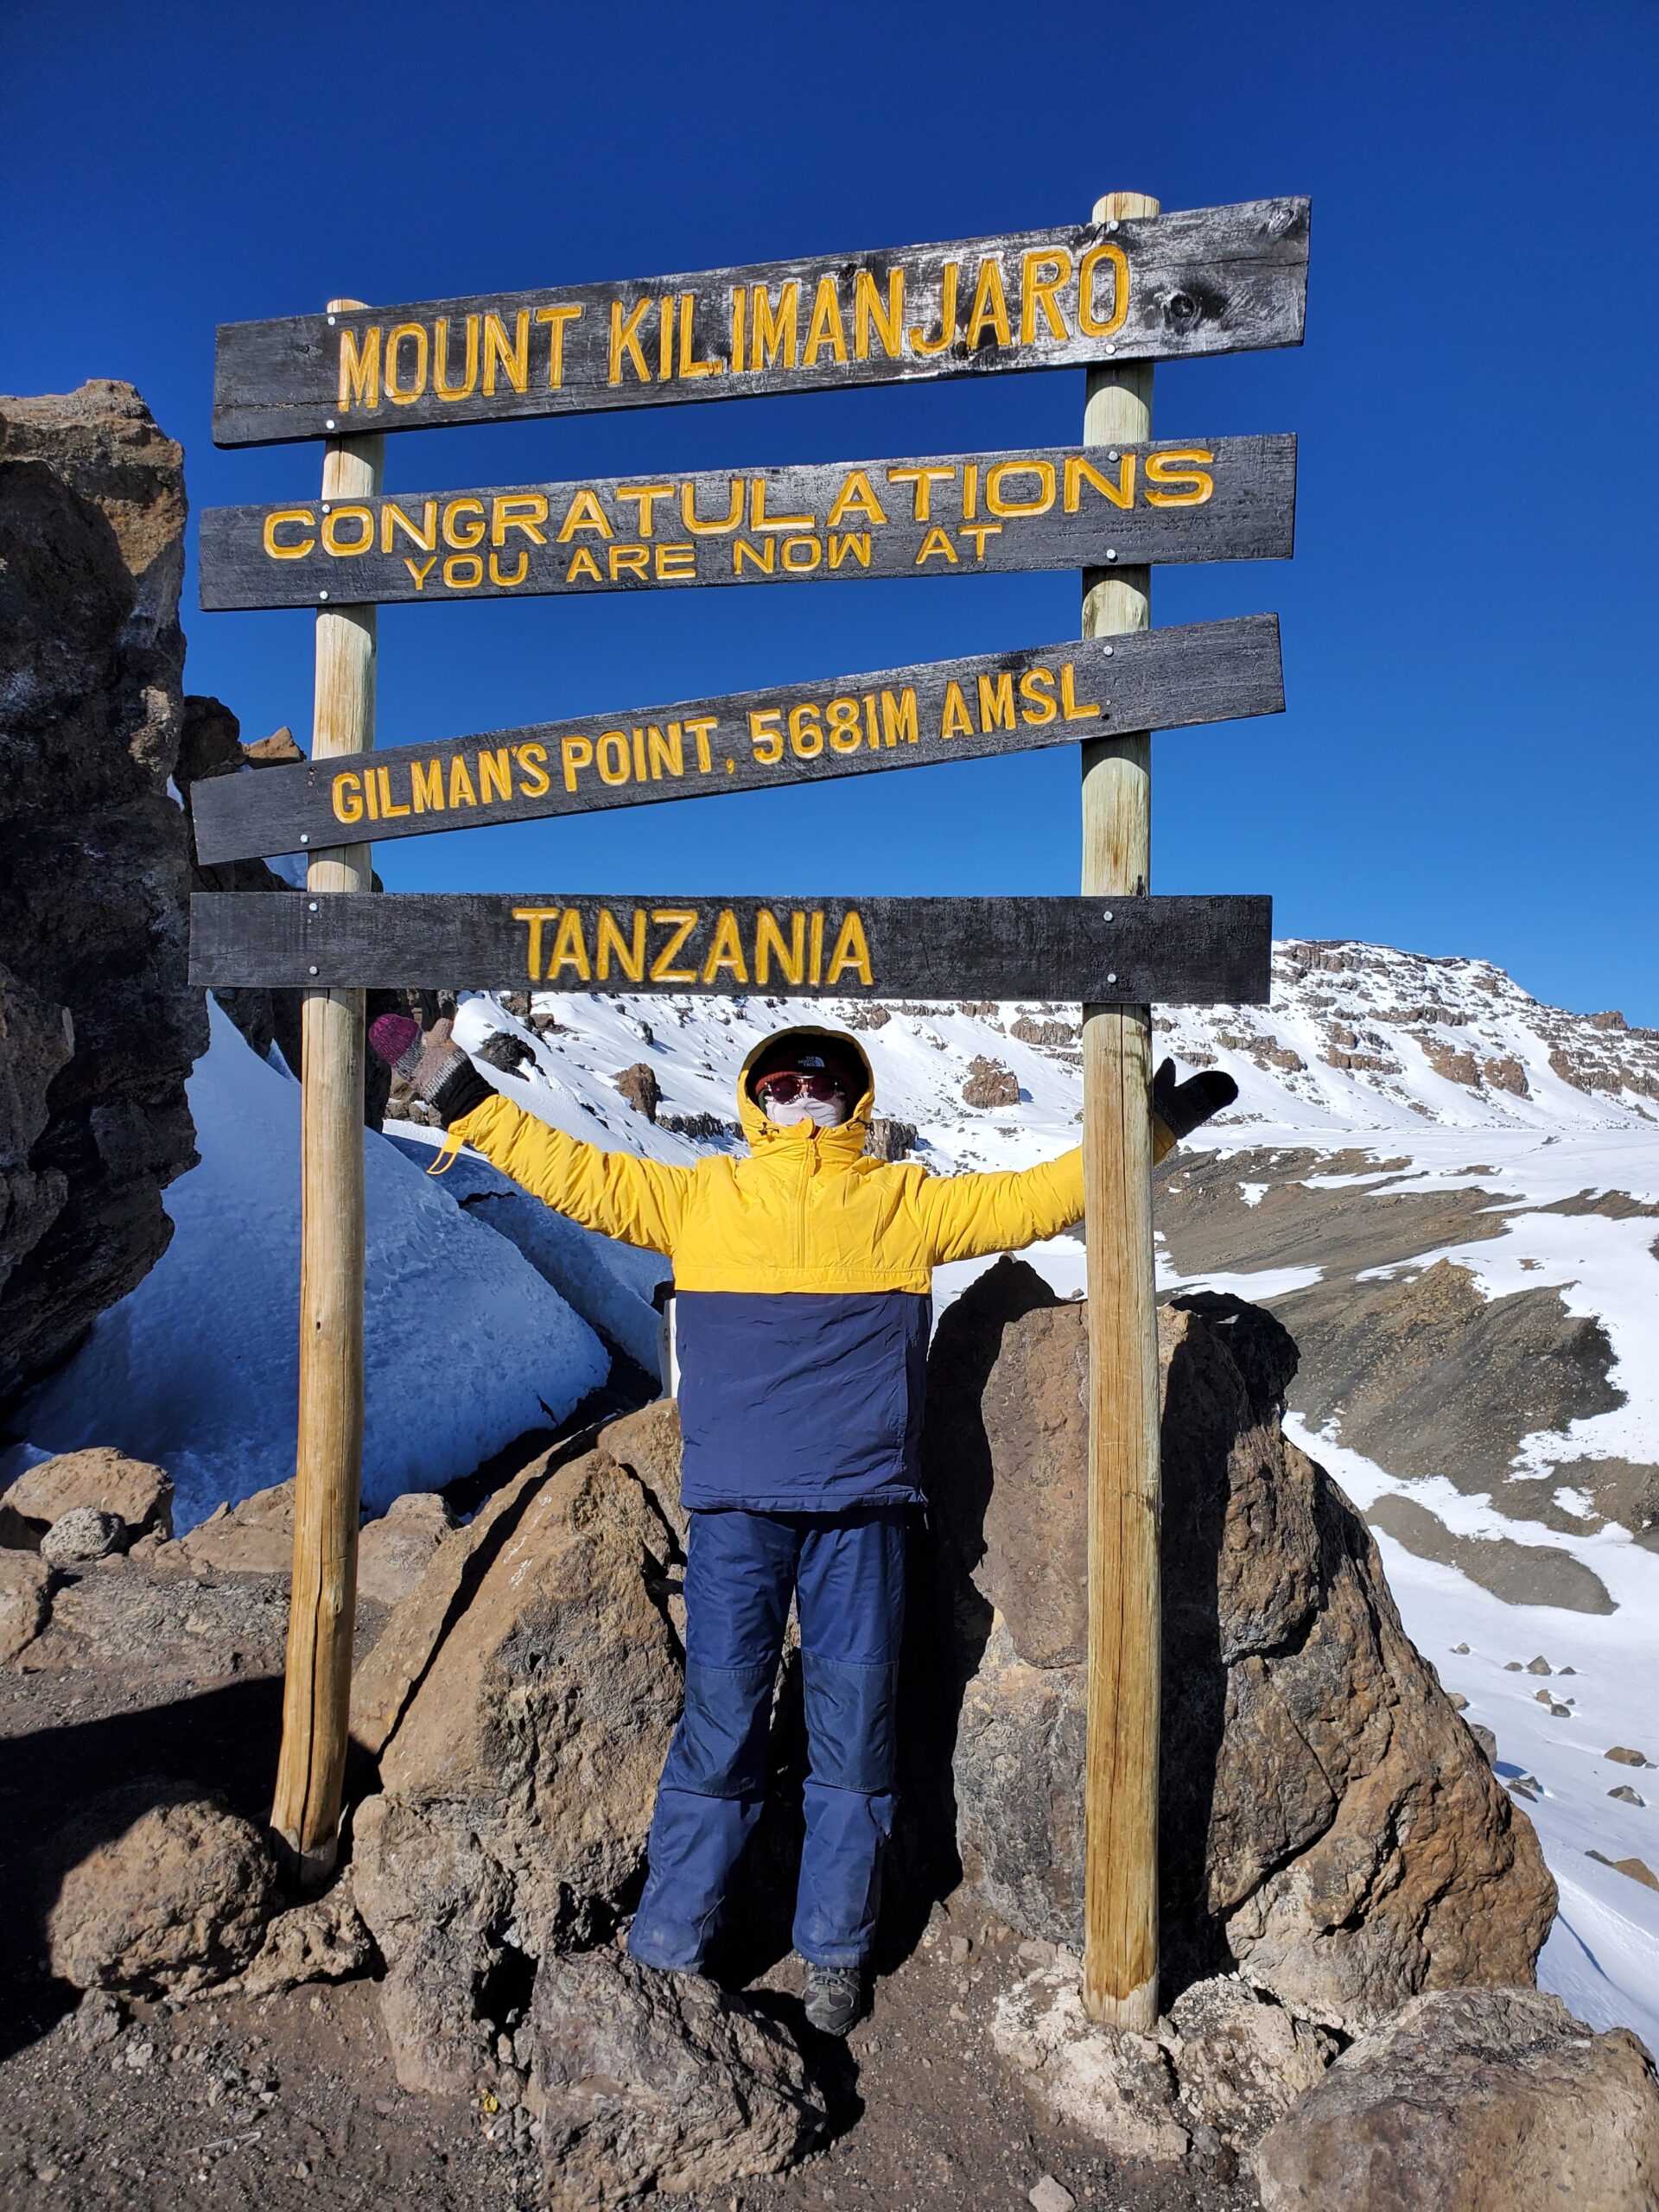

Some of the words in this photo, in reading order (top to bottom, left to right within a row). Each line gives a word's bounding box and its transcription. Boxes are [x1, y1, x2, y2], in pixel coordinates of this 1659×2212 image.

[337, 305, 582, 412] MOUNT
[607, 244, 1129, 385] KILIMANJARO
[264, 448, 1215, 558] CONGRATULATIONS
[404, 551, 530, 590] YOU
[566, 543, 698, 582] ARE
[733, 532, 872, 573] NOW
[916, 524, 1004, 563] AT
[332, 742, 550, 823] GILMAN'S
[561, 716, 736, 791] POINT,
[748, 687, 920, 766] 5681M
[941, 663, 1103, 738] AMSL
[512, 906, 874, 986] TANZANIA
